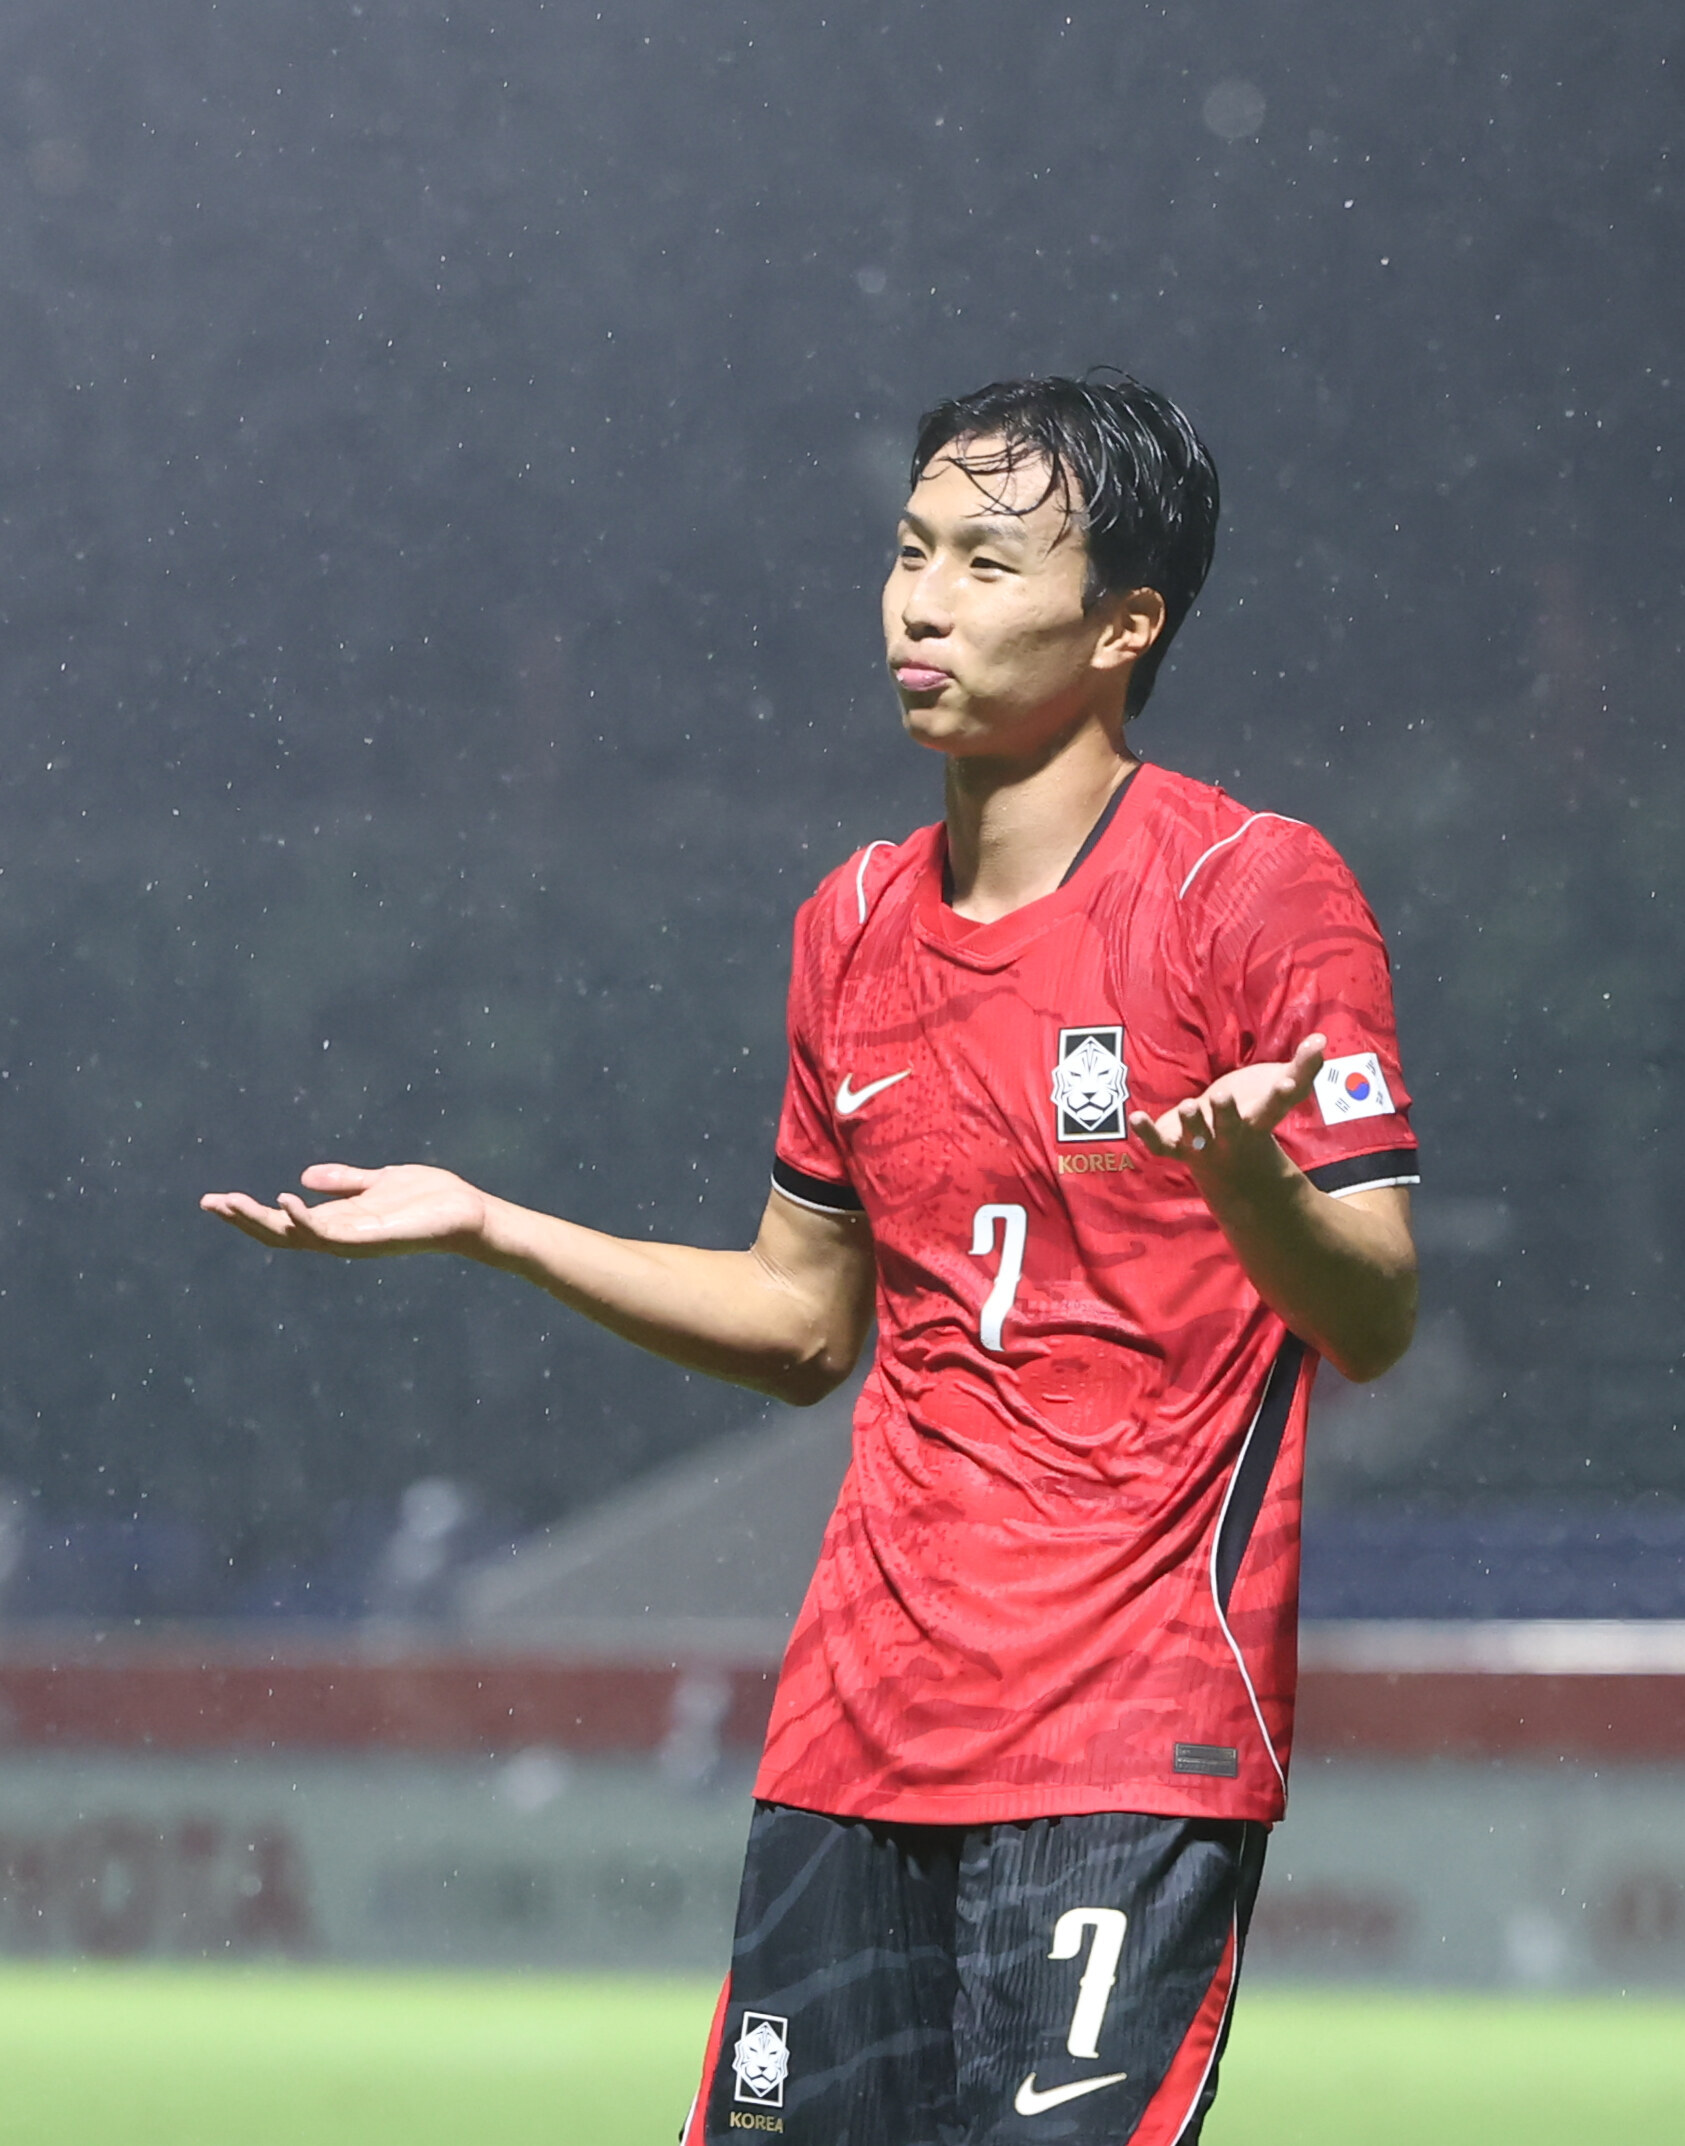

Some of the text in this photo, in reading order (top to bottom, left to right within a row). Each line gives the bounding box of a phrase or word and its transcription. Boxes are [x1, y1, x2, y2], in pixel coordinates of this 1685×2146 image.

[1058, 1152, 1135, 1174] KOREA
[968, 1203, 1027, 1351] 7
[1047, 1907, 1127, 2059] 7
[729, 2111, 784, 2133] KOREA
